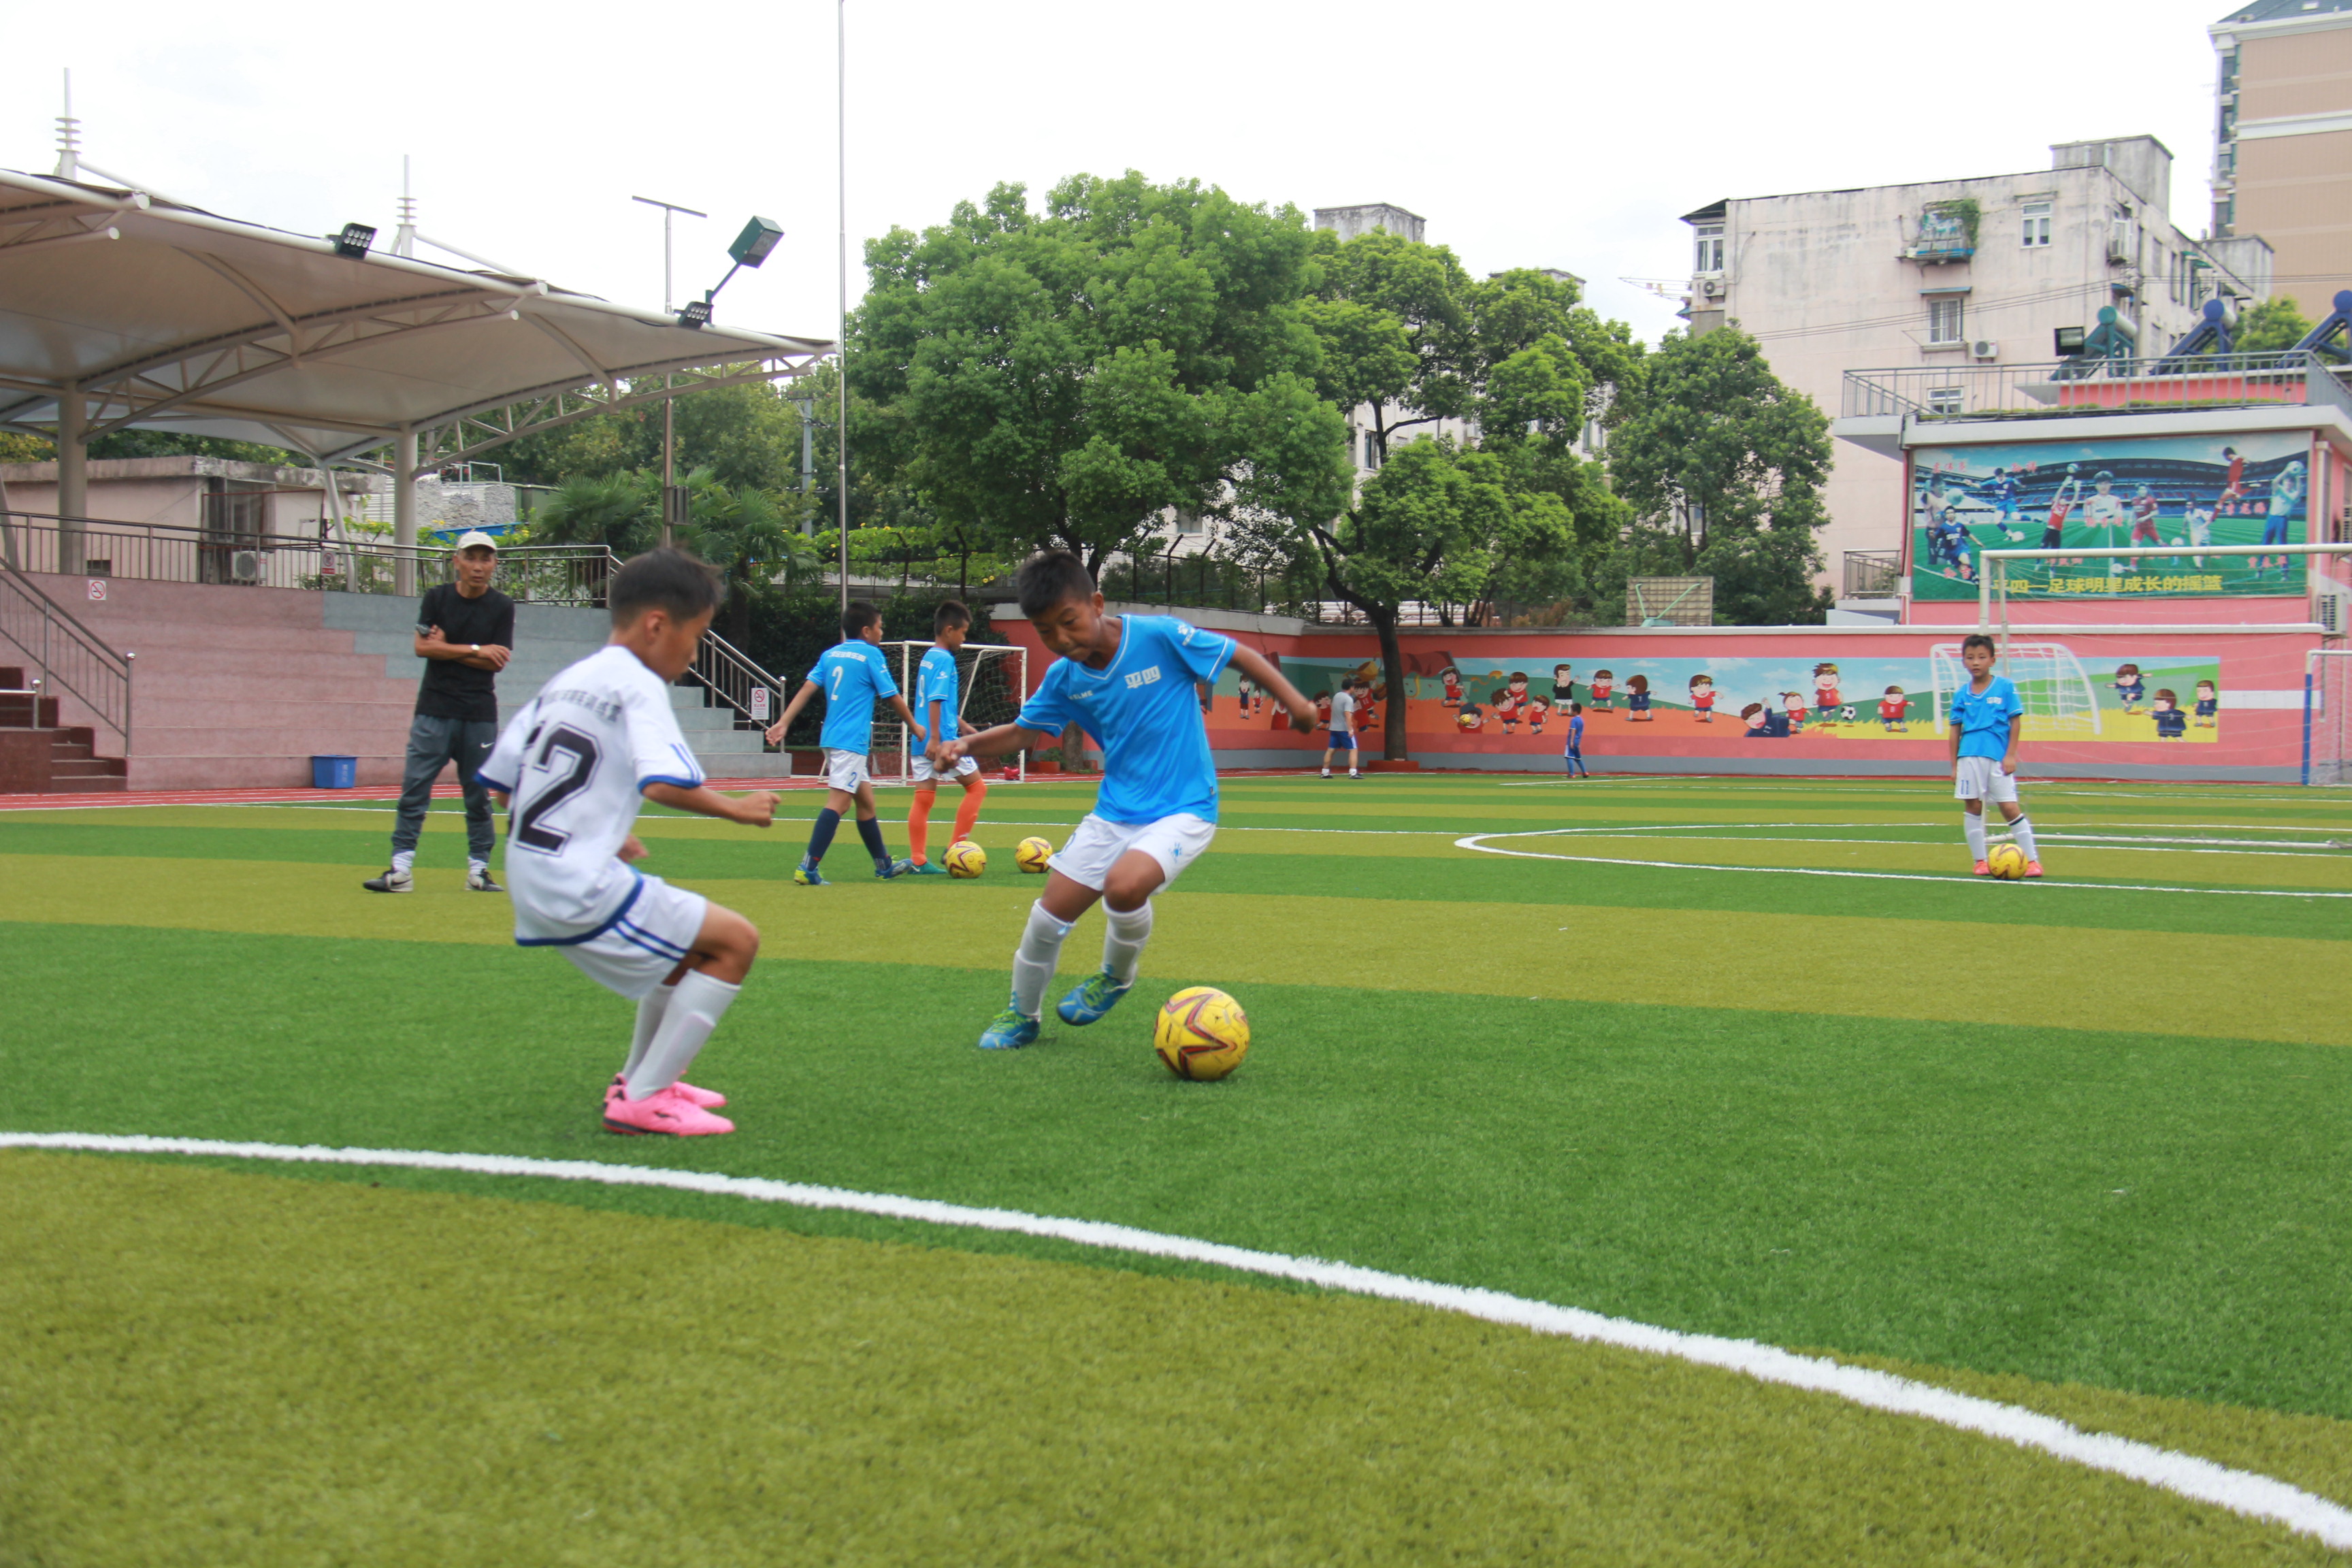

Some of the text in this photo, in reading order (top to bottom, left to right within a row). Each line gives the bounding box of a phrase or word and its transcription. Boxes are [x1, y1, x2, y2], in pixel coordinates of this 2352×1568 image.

[831, 666, 843, 700] 2
[1124, 665, 1161, 689] 平四
[919, 674, 925, 707] 9
[848, 771, 858, 788] 2
[1961, 779, 1970, 795] 11
